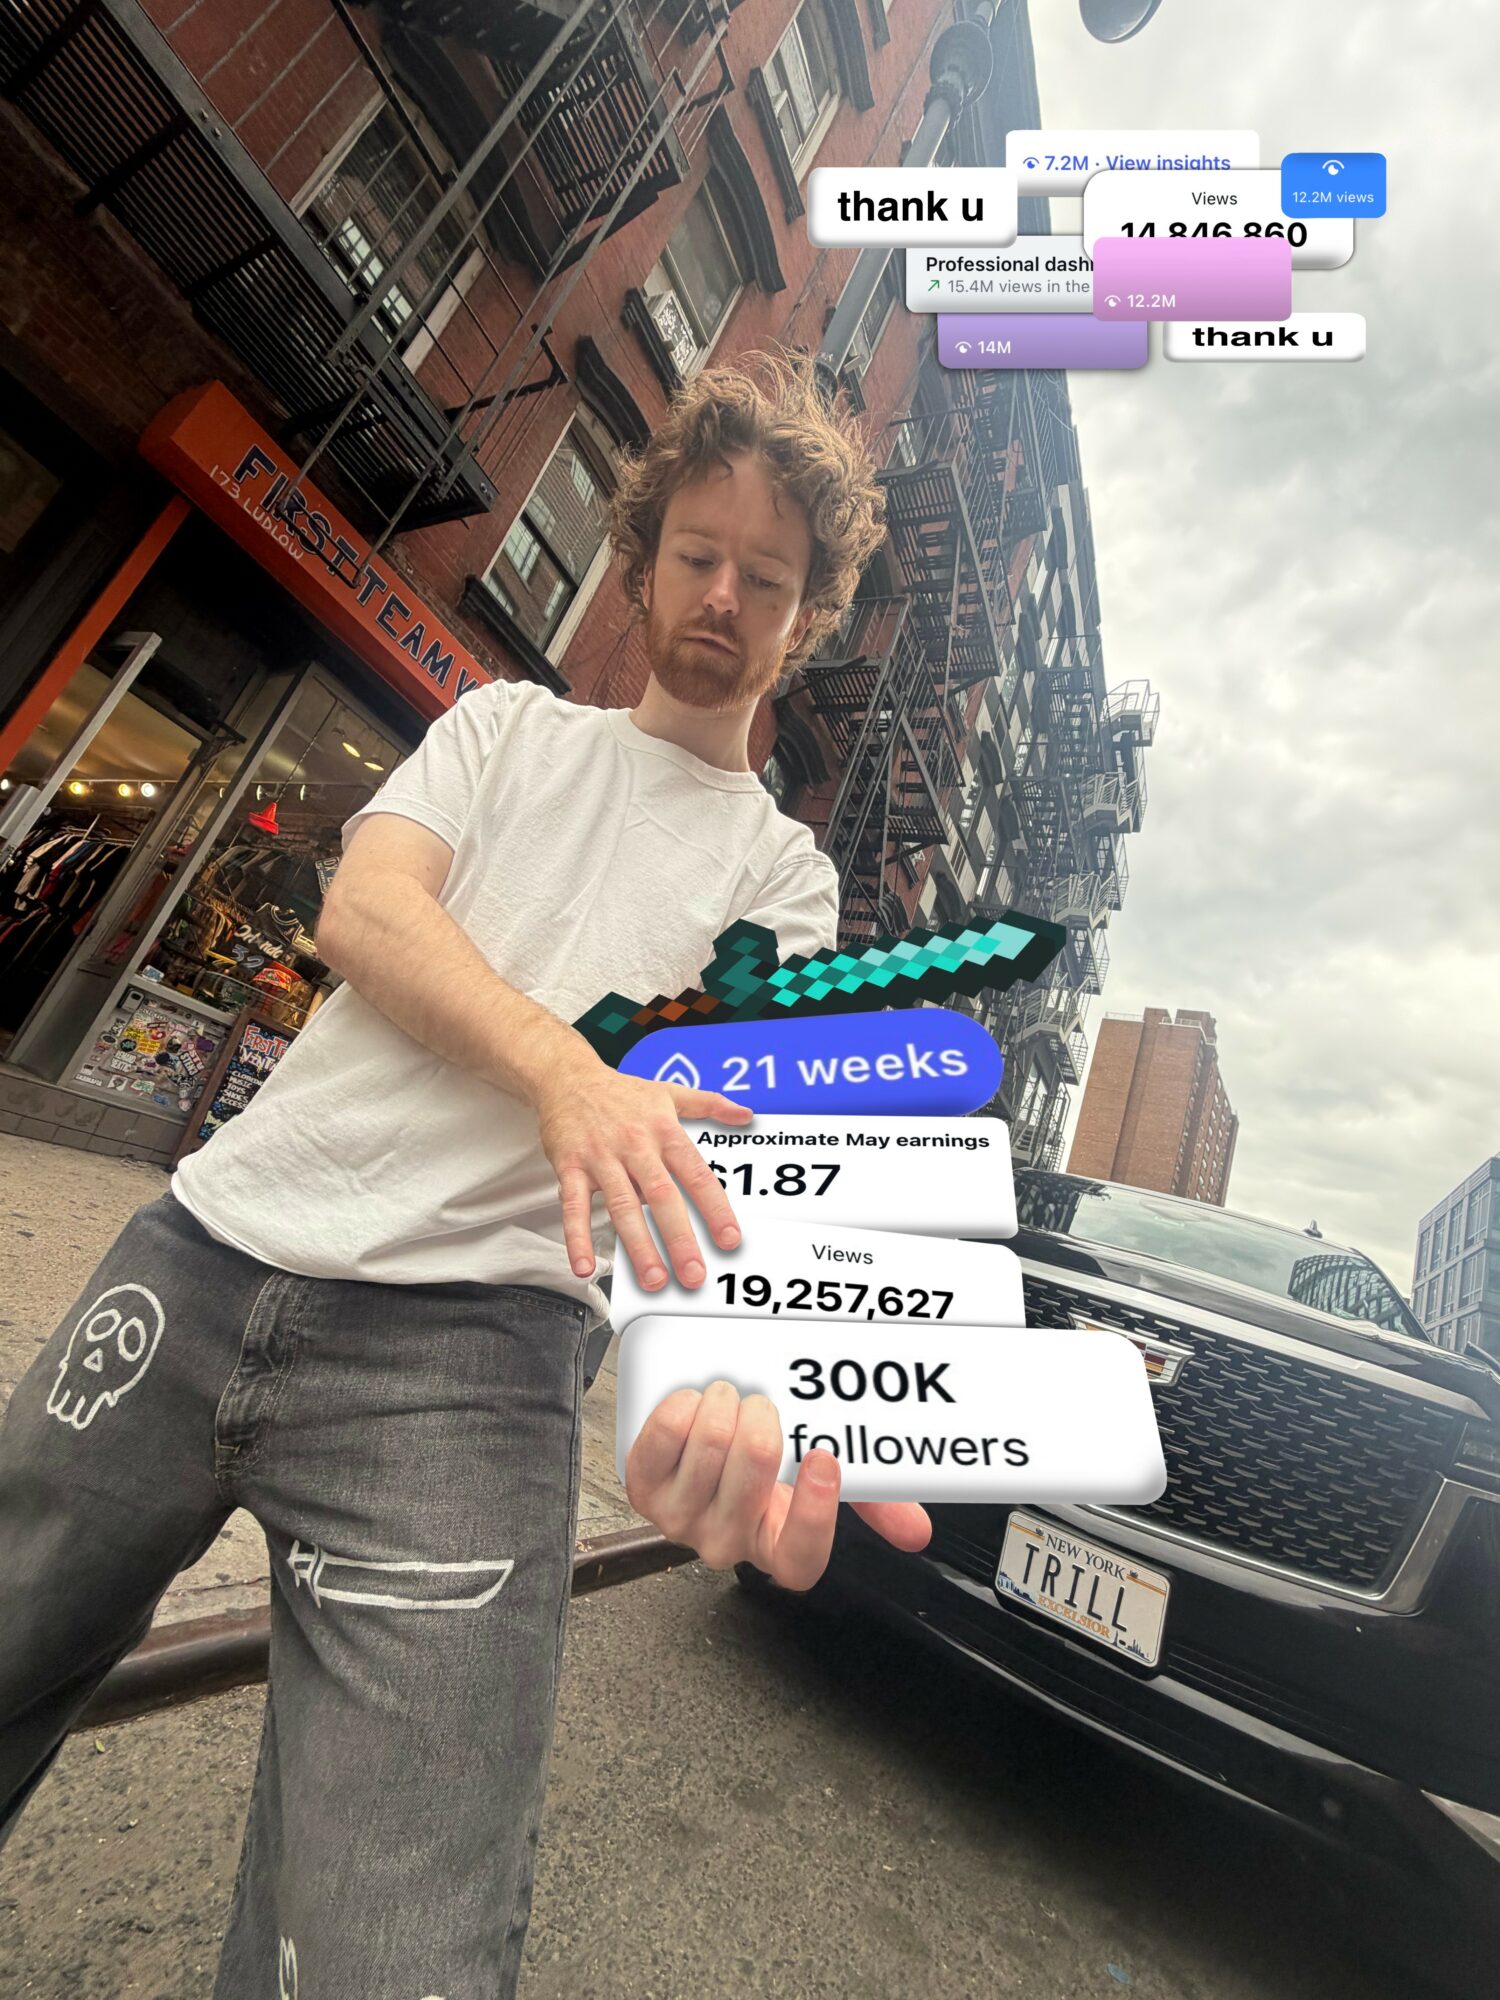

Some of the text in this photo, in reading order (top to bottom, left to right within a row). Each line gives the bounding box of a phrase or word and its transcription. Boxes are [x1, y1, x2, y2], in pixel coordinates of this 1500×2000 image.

[209, 464, 304, 560] 173 LUDLOW
[232, 444, 360, 576] FIRST
[356, 563, 455, 688] TEAM
[233, 924, 284, 959] Orlndo
[242, 1025, 274, 1057] FIRST
[227, 1083, 246, 1095] TOYS
[1045, 1533, 1127, 1581] NEW YORK
[1022, 1542, 1128, 1632] TRILL
[1038, 1594, 1111, 1639] EXCELSIOR
